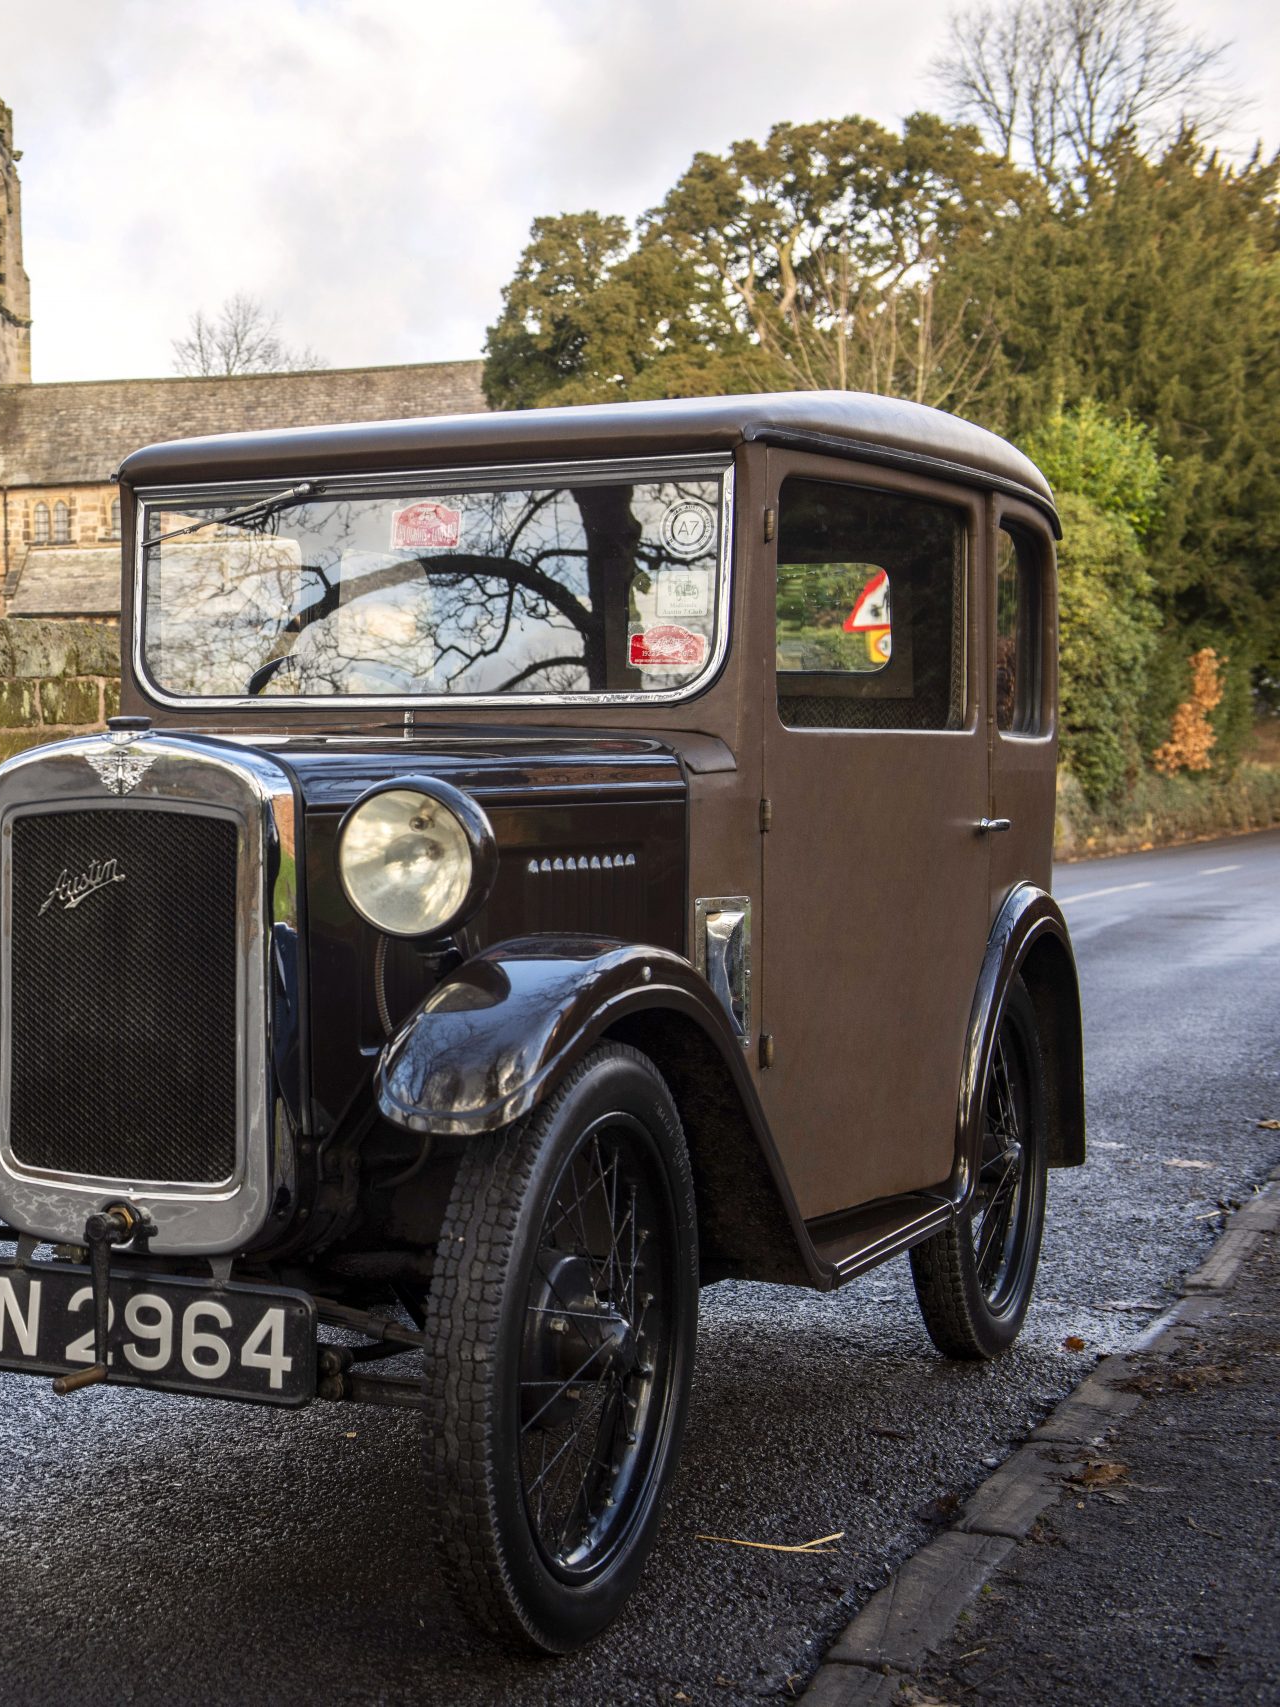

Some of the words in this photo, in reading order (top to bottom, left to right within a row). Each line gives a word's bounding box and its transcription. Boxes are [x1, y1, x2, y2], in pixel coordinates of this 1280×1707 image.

[677, 520, 700, 536] A7
[37, 858, 122, 916] Austin
[65, 1285, 293, 1390] 2964
